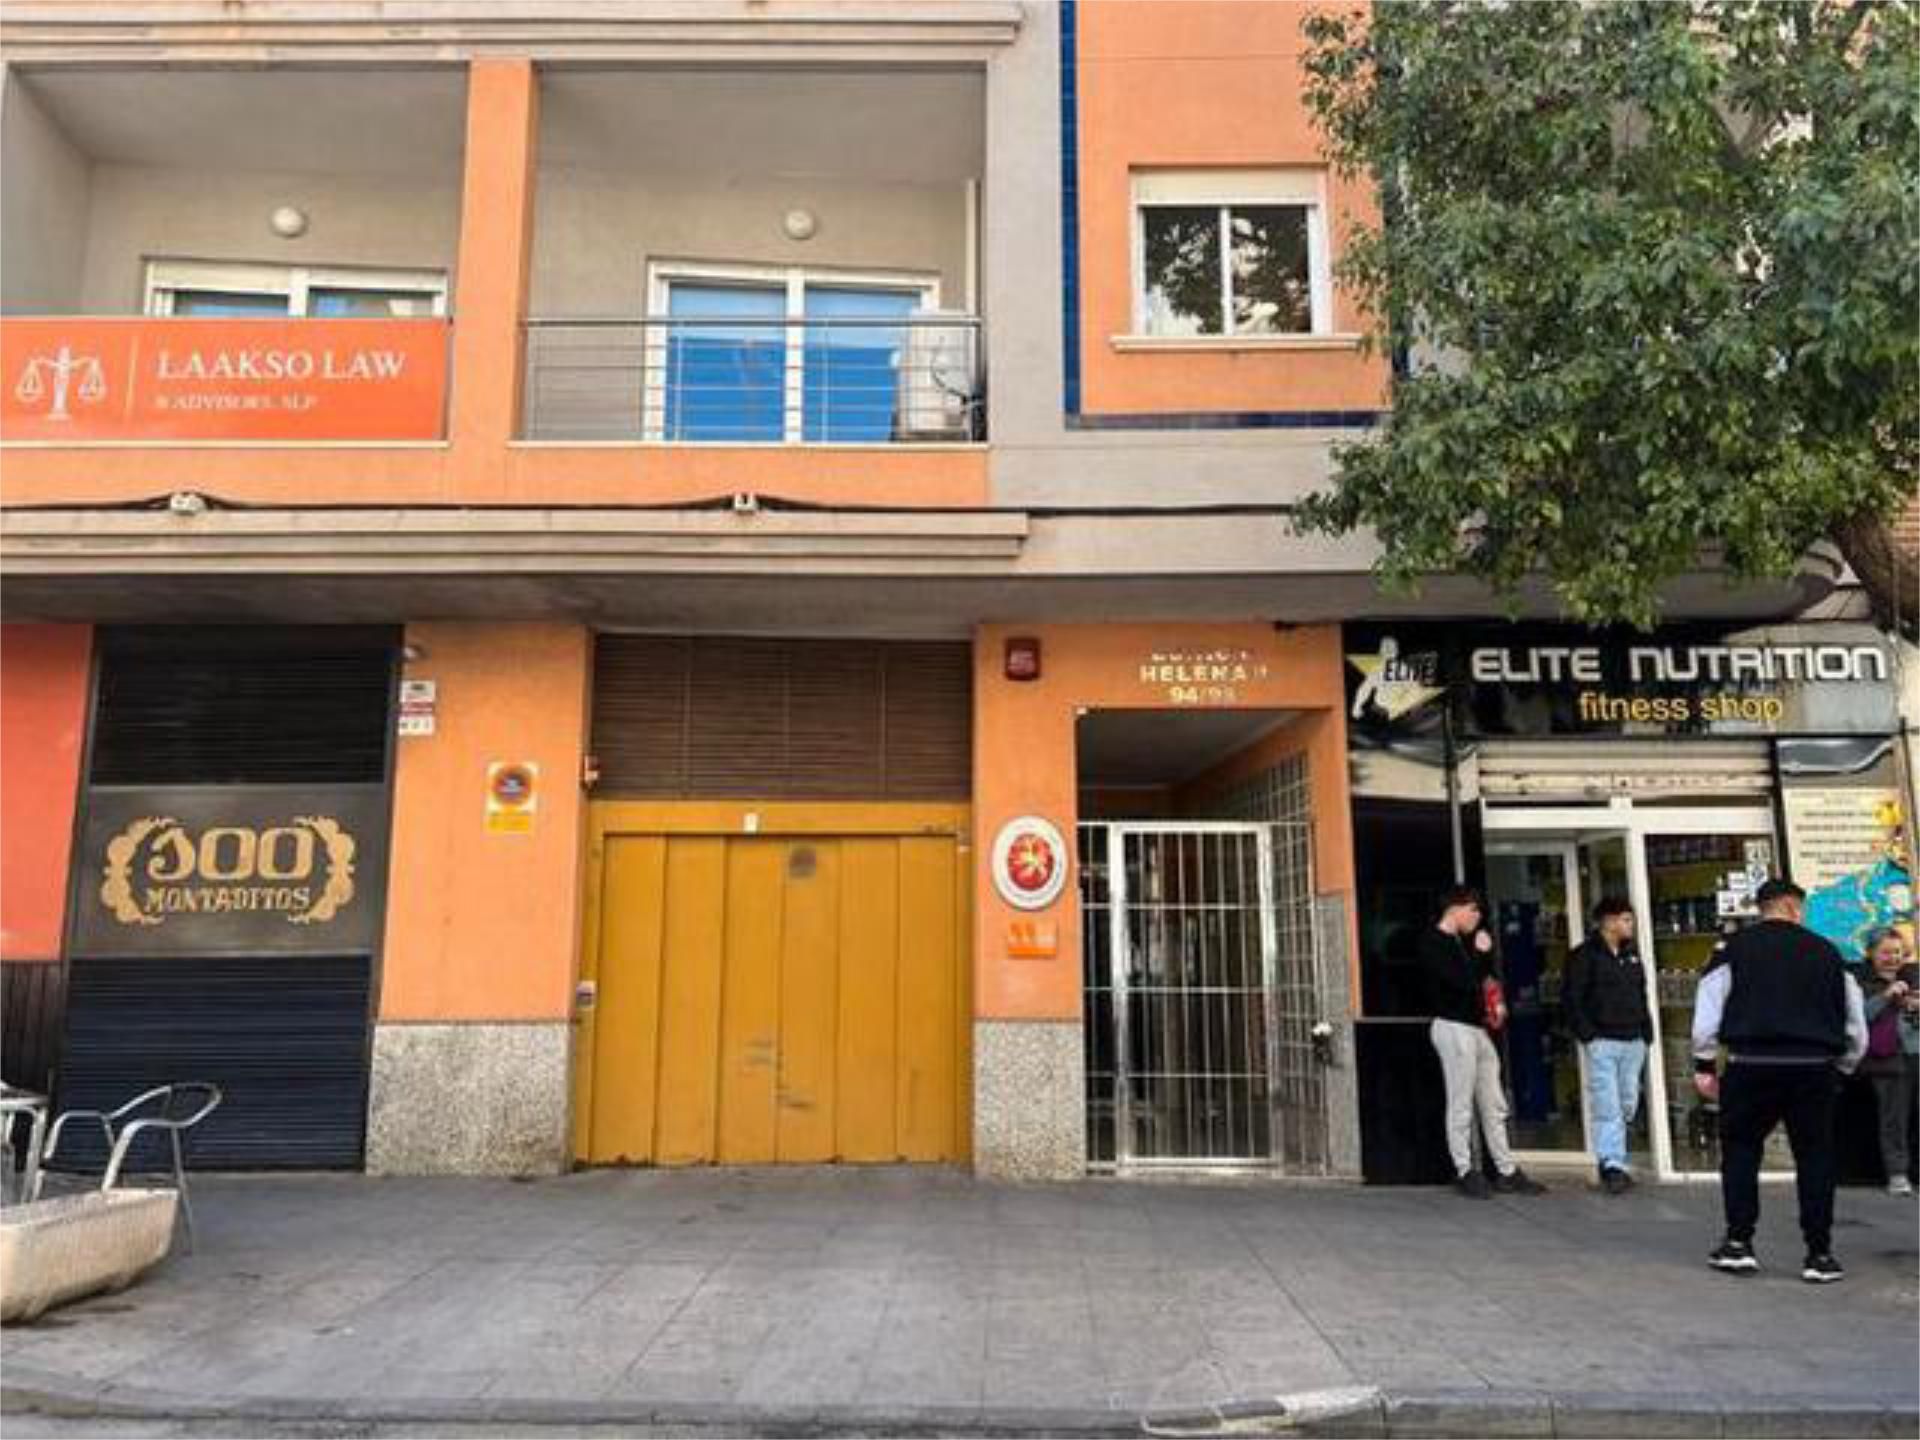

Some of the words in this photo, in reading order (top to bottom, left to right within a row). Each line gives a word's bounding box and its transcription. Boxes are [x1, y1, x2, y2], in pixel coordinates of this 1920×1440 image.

[158, 350, 313, 379] LAAKSO
[323, 350, 406, 379] LAW
[1139, 664, 1248, 682] HELENA
[1471, 646, 1600, 682] ELITE
[1629, 646, 1888, 681] NUTRITION
[1579, 691, 1690, 722] fitness
[1700, 692, 1785, 724] shop
[145, 885, 311, 913] MONTADITOS
